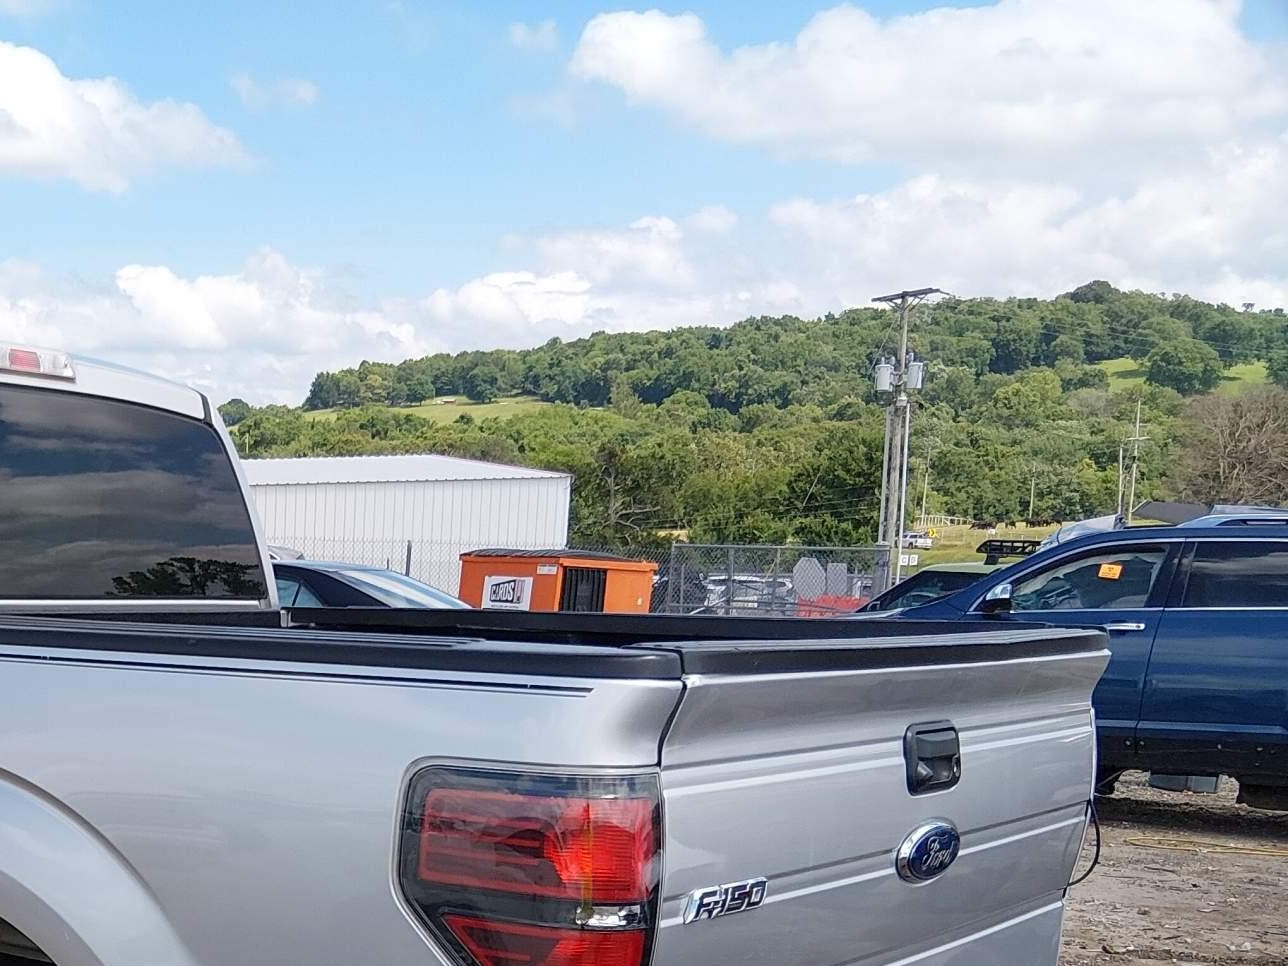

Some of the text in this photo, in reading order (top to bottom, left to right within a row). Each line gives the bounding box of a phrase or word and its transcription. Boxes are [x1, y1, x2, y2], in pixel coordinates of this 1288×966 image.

[490, 581, 516, 601] CARDS
[920, 834, 955, 871] Ford
[692, 879, 768, 921] F-150
